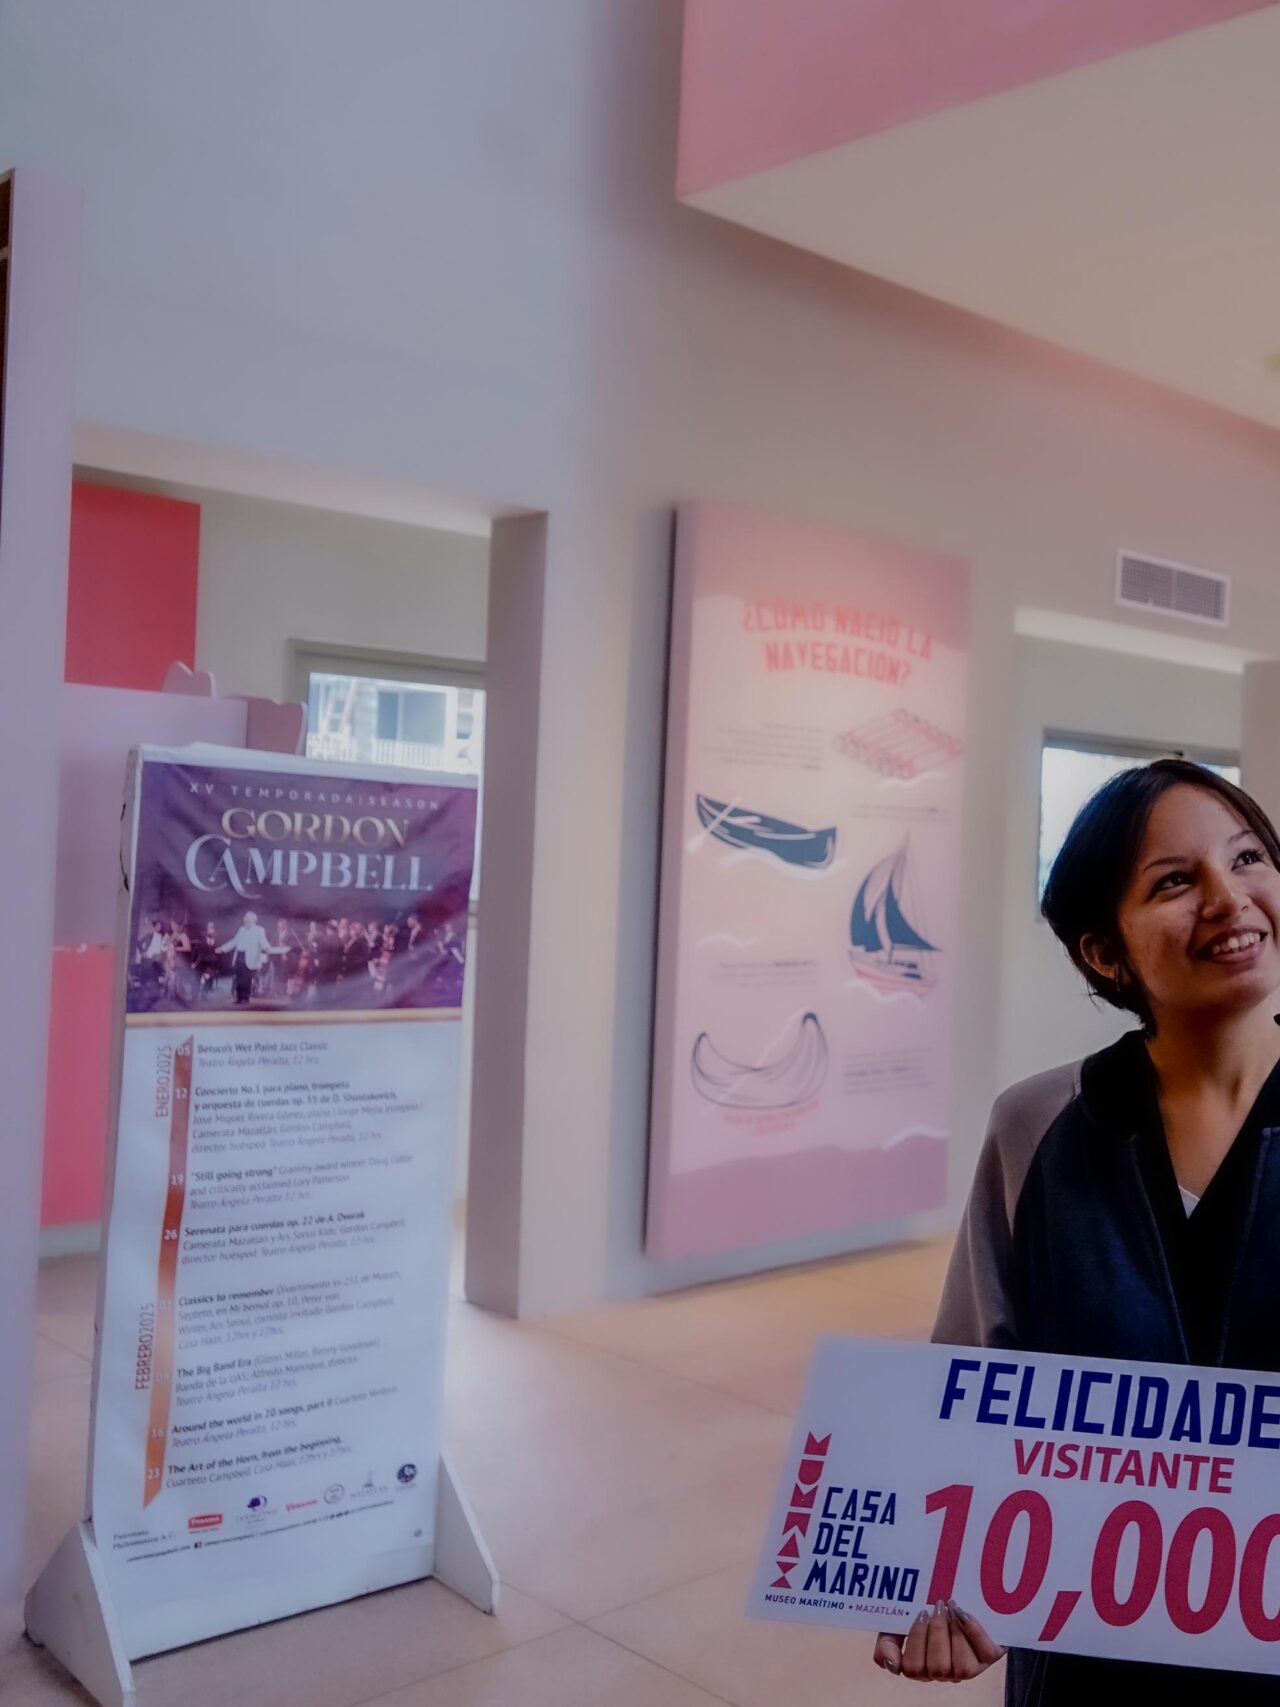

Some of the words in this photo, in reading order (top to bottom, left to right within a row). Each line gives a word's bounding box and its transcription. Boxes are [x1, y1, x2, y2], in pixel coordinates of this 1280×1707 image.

[190, 782, 214, 794] XV
[221, 807, 409, 849] GORDON
[185, 834, 434, 899] CAMPBELL
[234, 1042, 251, 1052] Wet
[255, 1042, 277, 1051] Paint
[280, 1041, 297, 1051] Jazz
[300, 1041, 328, 1050] Classic
[176, 1088, 188, 1099] 12
[195, 1086, 238, 1096] Concierto
[201, 1099, 241, 1111] orquesta
[244, 1098, 255, 1108] de
[319, 1094, 331, 1103] de
[171, 1174, 184, 1185] 19
[216, 1170, 242, 1181] going
[190, 1186, 206, 1196] and
[164, 1229, 177, 1240] 26
[185, 1224, 226, 1237] Serenata
[229, 1223, 248, 1234] para
[315, 1215, 326, 1225] de
[179, 1293, 213, 1306] Classics
[216, 1292, 227, 1302] to
[228, 1288, 274, 1301] remember
[216, 1305, 227, 1314] en
[177, 1367, 194, 1379] The
[196, 1365, 211, 1377] Big
[213, 1360, 235, 1373] Band
[238, 1358, 252, 1368] Era
[176, 1381, 204, 1394] Banda
[206, 1379, 217, 1389] de
[172, 1422, 206, 1434] Around
[209, 1418, 223, 1429] the
[226, 1413, 251, 1425] world
[265, 1408, 276, 1419] 20
[307, 1400, 325, 1412] part
[151, 1428, 164, 1438] 16
[168, 1464, 185, 1475] The
[189, 1462, 203, 1473] Art
[205, 1459, 216, 1470] of
[218, 1457, 233, 1467] the
[261, 1448, 282, 1460] from
[284, 1445, 297, 1455] the
[1013, 1438, 1236, 1494] VISITANTE
[166, 1476, 207, 1489] Cuarteto
[821, 1486, 897, 1526] CASA
[812, 1521, 868, 1560] DEL
[802, 1559, 920, 1603] MARINO
[764, 1594, 797, 1605] MUSEO
[799, 1597, 845, 1610] MARÍTIMO
[855, 1603, 904, 1617] MAZATLÁN
